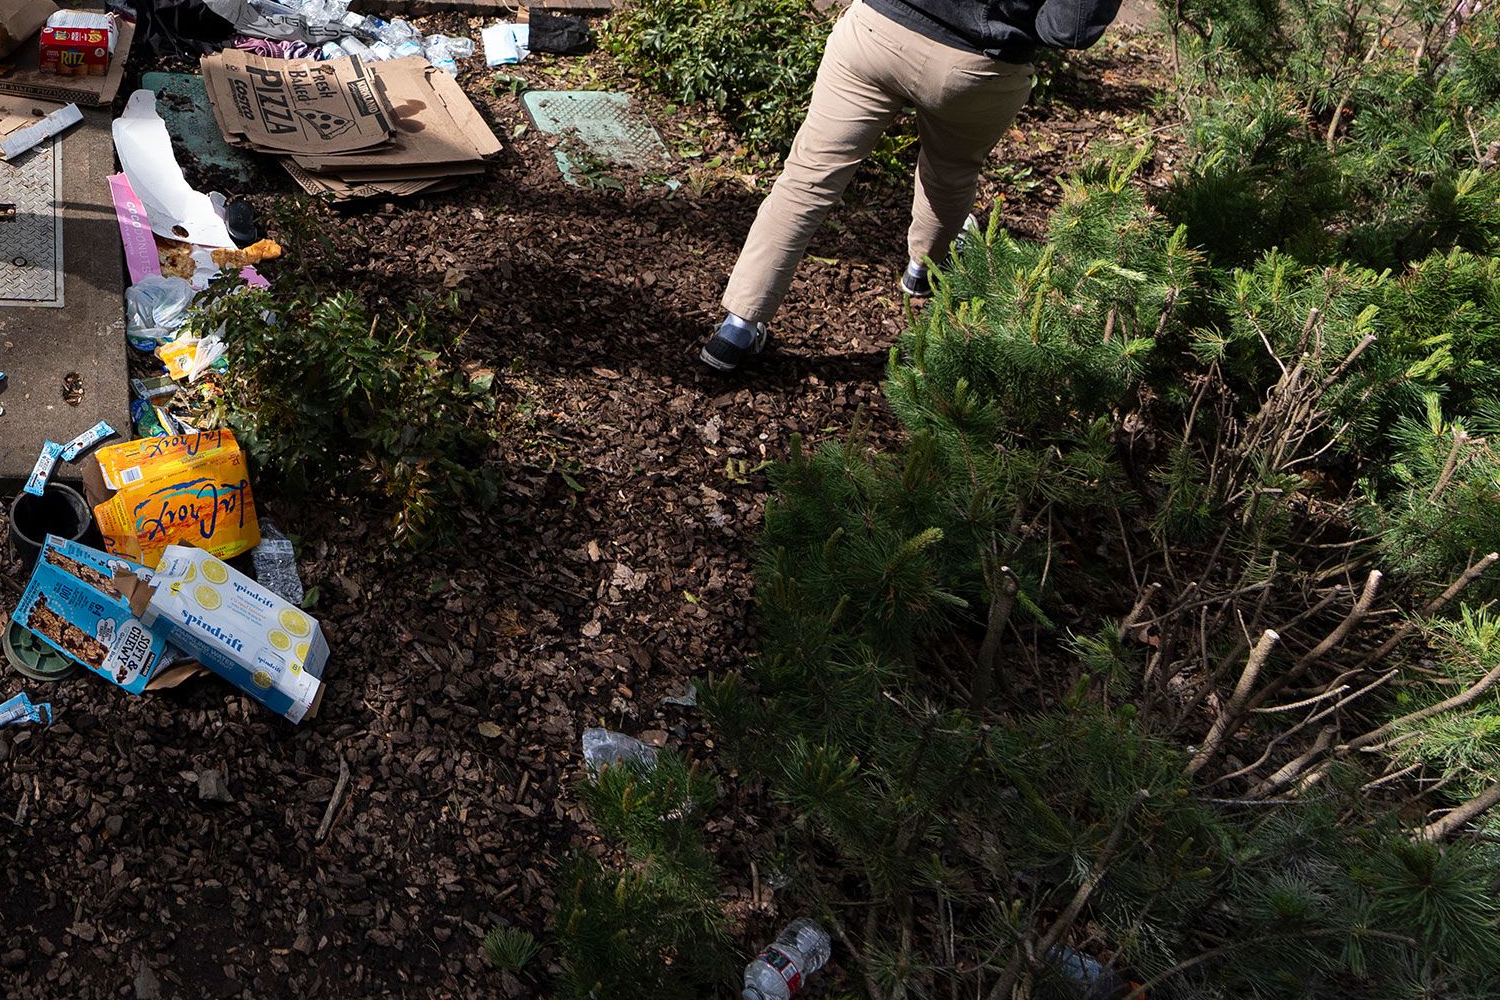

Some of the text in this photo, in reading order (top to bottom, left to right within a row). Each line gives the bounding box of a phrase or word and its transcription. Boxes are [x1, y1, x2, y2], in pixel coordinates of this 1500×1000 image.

[61, 50, 85, 65] RITZ
[234, 79, 255, 120] COSTCO
[245, 65, 299, 134] PIZZA
[356, 78, 378, 113] KIRKLAND
[93, 604, 104, 617] 64
[233, 581, 274, 608] spindrift
[117, 626, 142, 665] CHEWY
[180, 609, 244, 653] spindrift
[127, 635, 151, 670] SOFT &
[209, 649, 236, 668] WATER
[257, 656, 282, 674] spindrift
